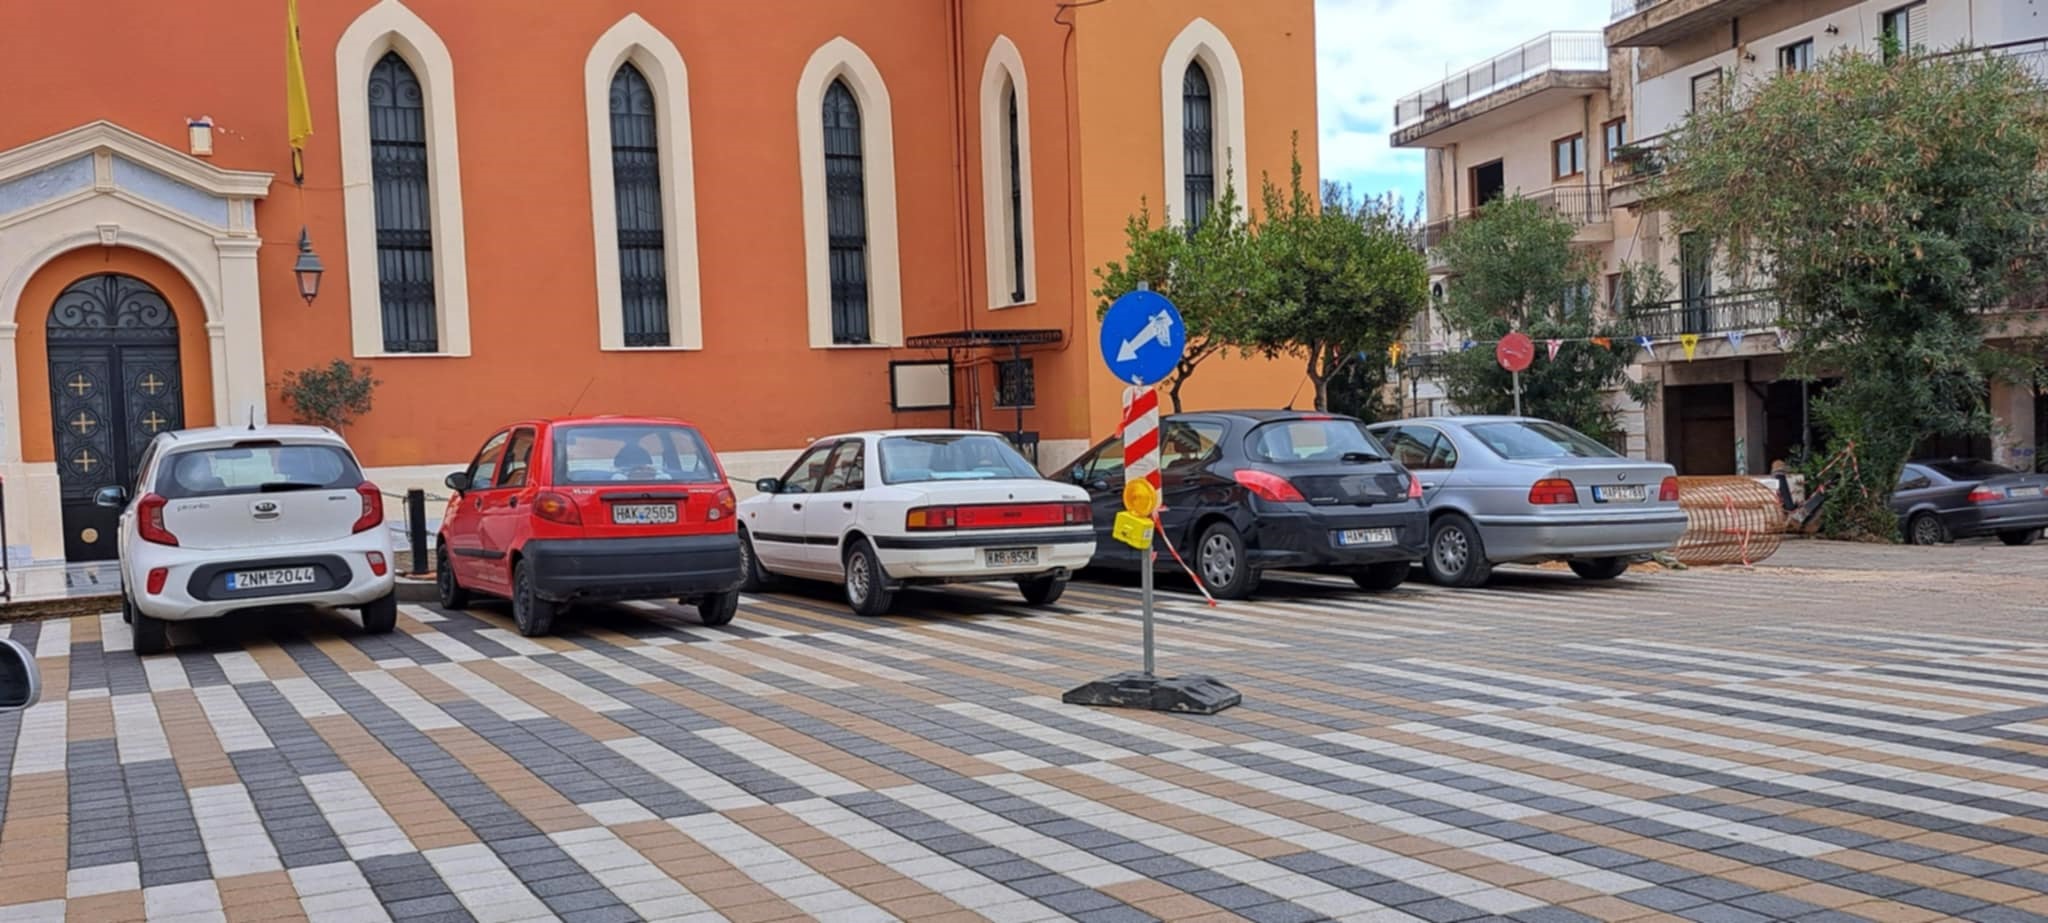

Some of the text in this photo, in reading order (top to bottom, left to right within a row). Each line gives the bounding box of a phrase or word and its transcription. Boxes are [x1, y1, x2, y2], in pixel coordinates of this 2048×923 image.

[644, 506, 675, 520] 2505
[239, 569, 313, 587] ZNM 2044
